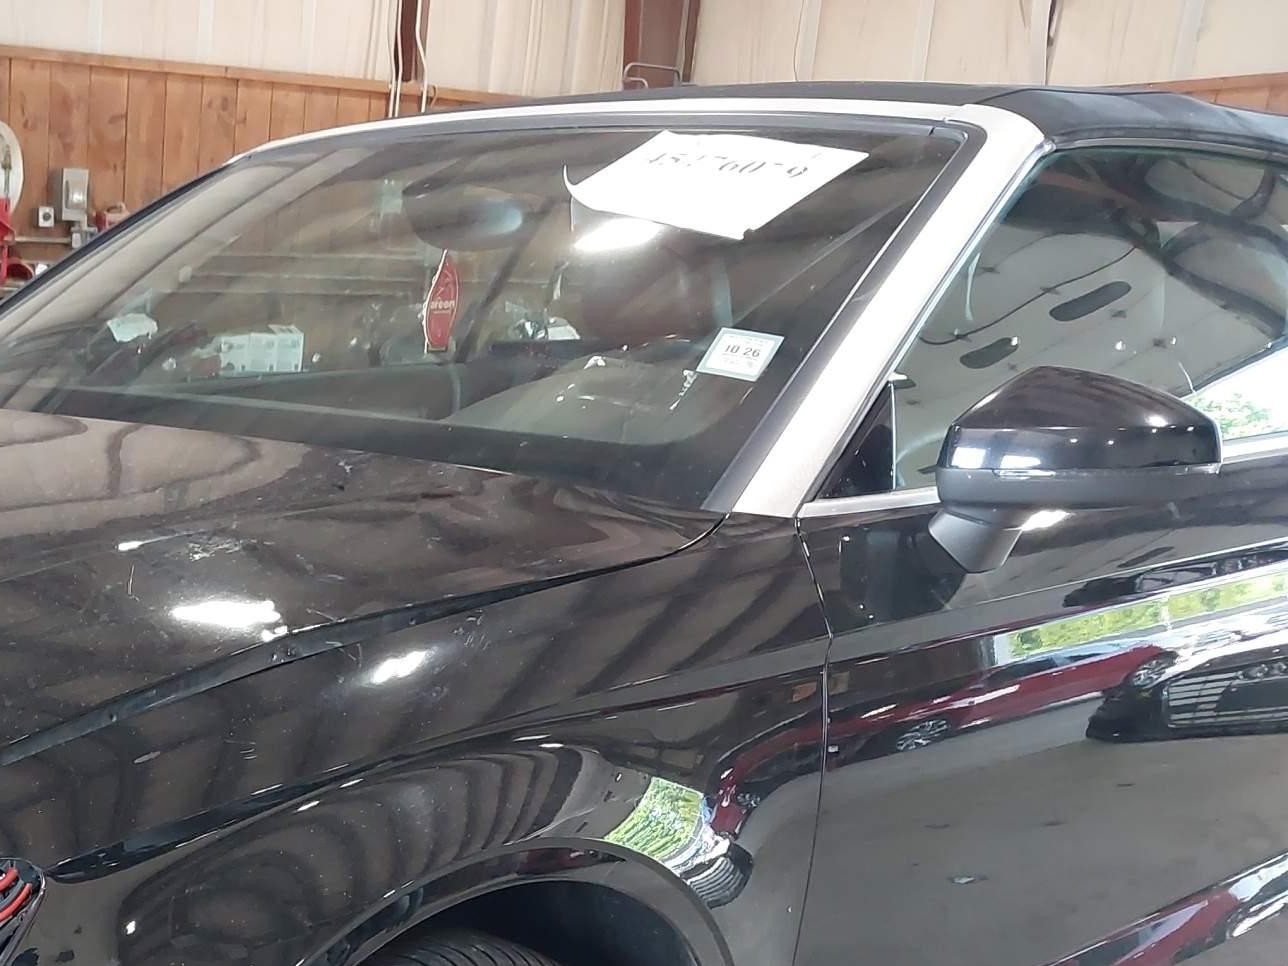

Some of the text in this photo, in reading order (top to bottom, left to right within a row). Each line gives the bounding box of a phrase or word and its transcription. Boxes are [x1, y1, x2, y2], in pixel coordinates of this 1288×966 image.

[646, 152, 809, 178] 45609
[724, 344, 761, 358] 10 26
